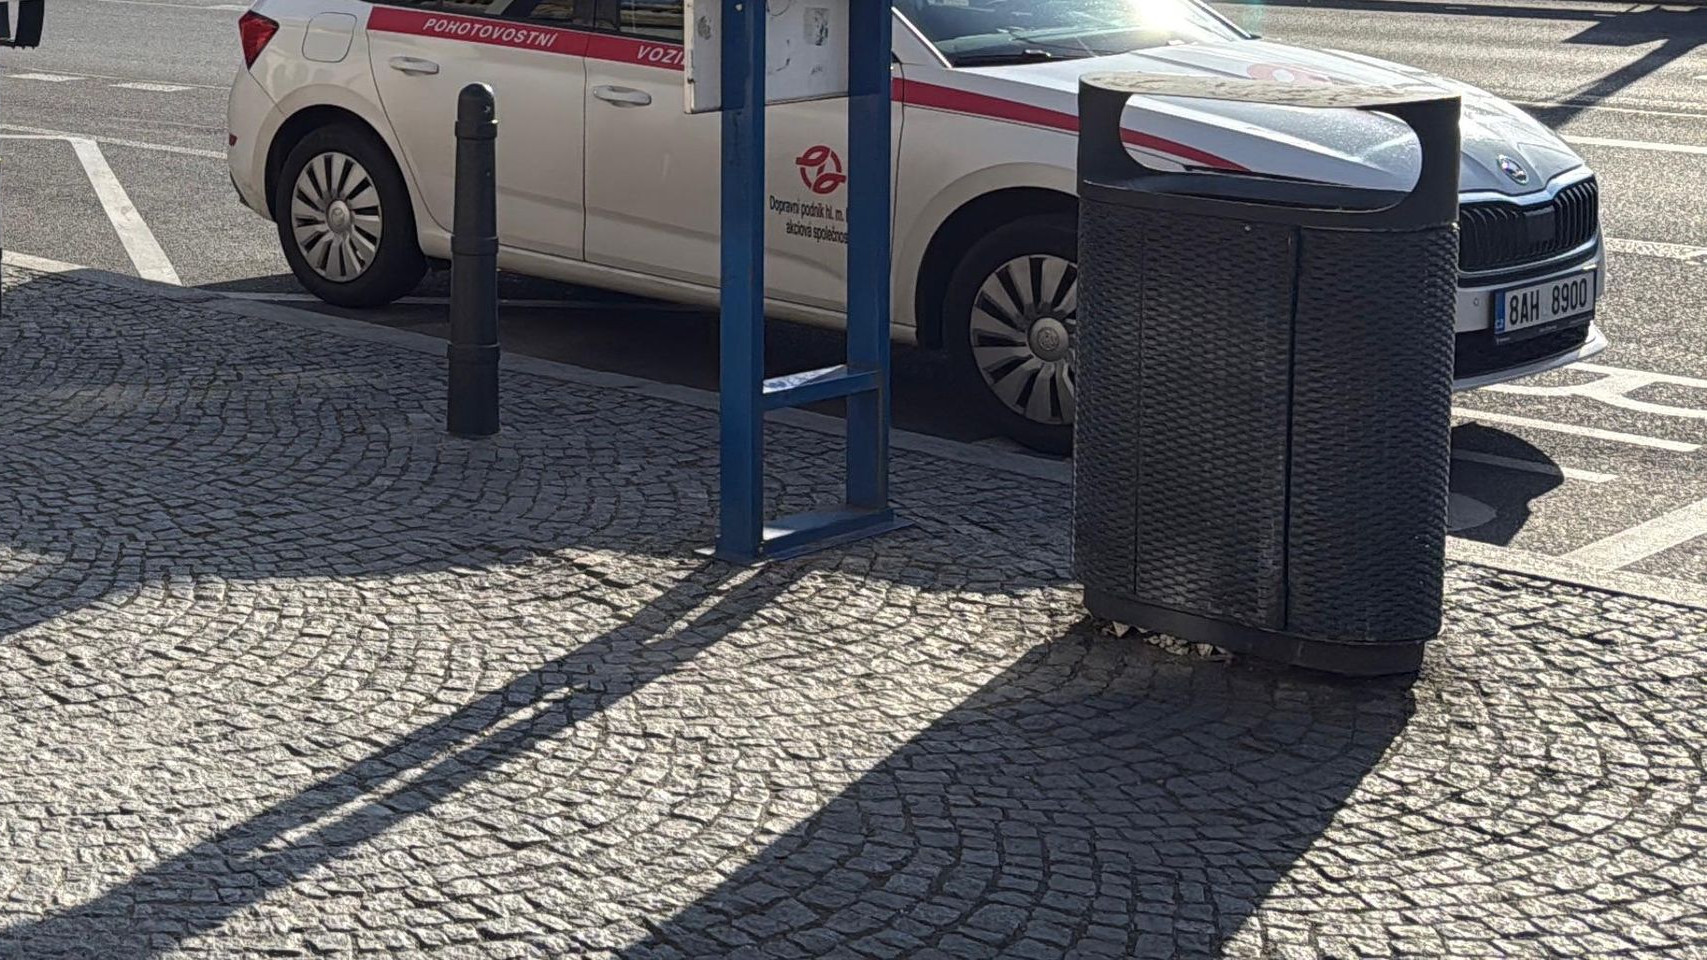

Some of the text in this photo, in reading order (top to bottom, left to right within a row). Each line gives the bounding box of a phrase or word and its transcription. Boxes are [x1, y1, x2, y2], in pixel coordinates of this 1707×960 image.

[423, 18, 684, 66] POHOTOVOSTNÍ VOZI
[770, 194, 799, 215] Dopravní
[801, 203, 824, 219] podnik
[786, 218, 849, 244] akciová společnos
[1510, 278, 1587, 326] 8AH 8900
